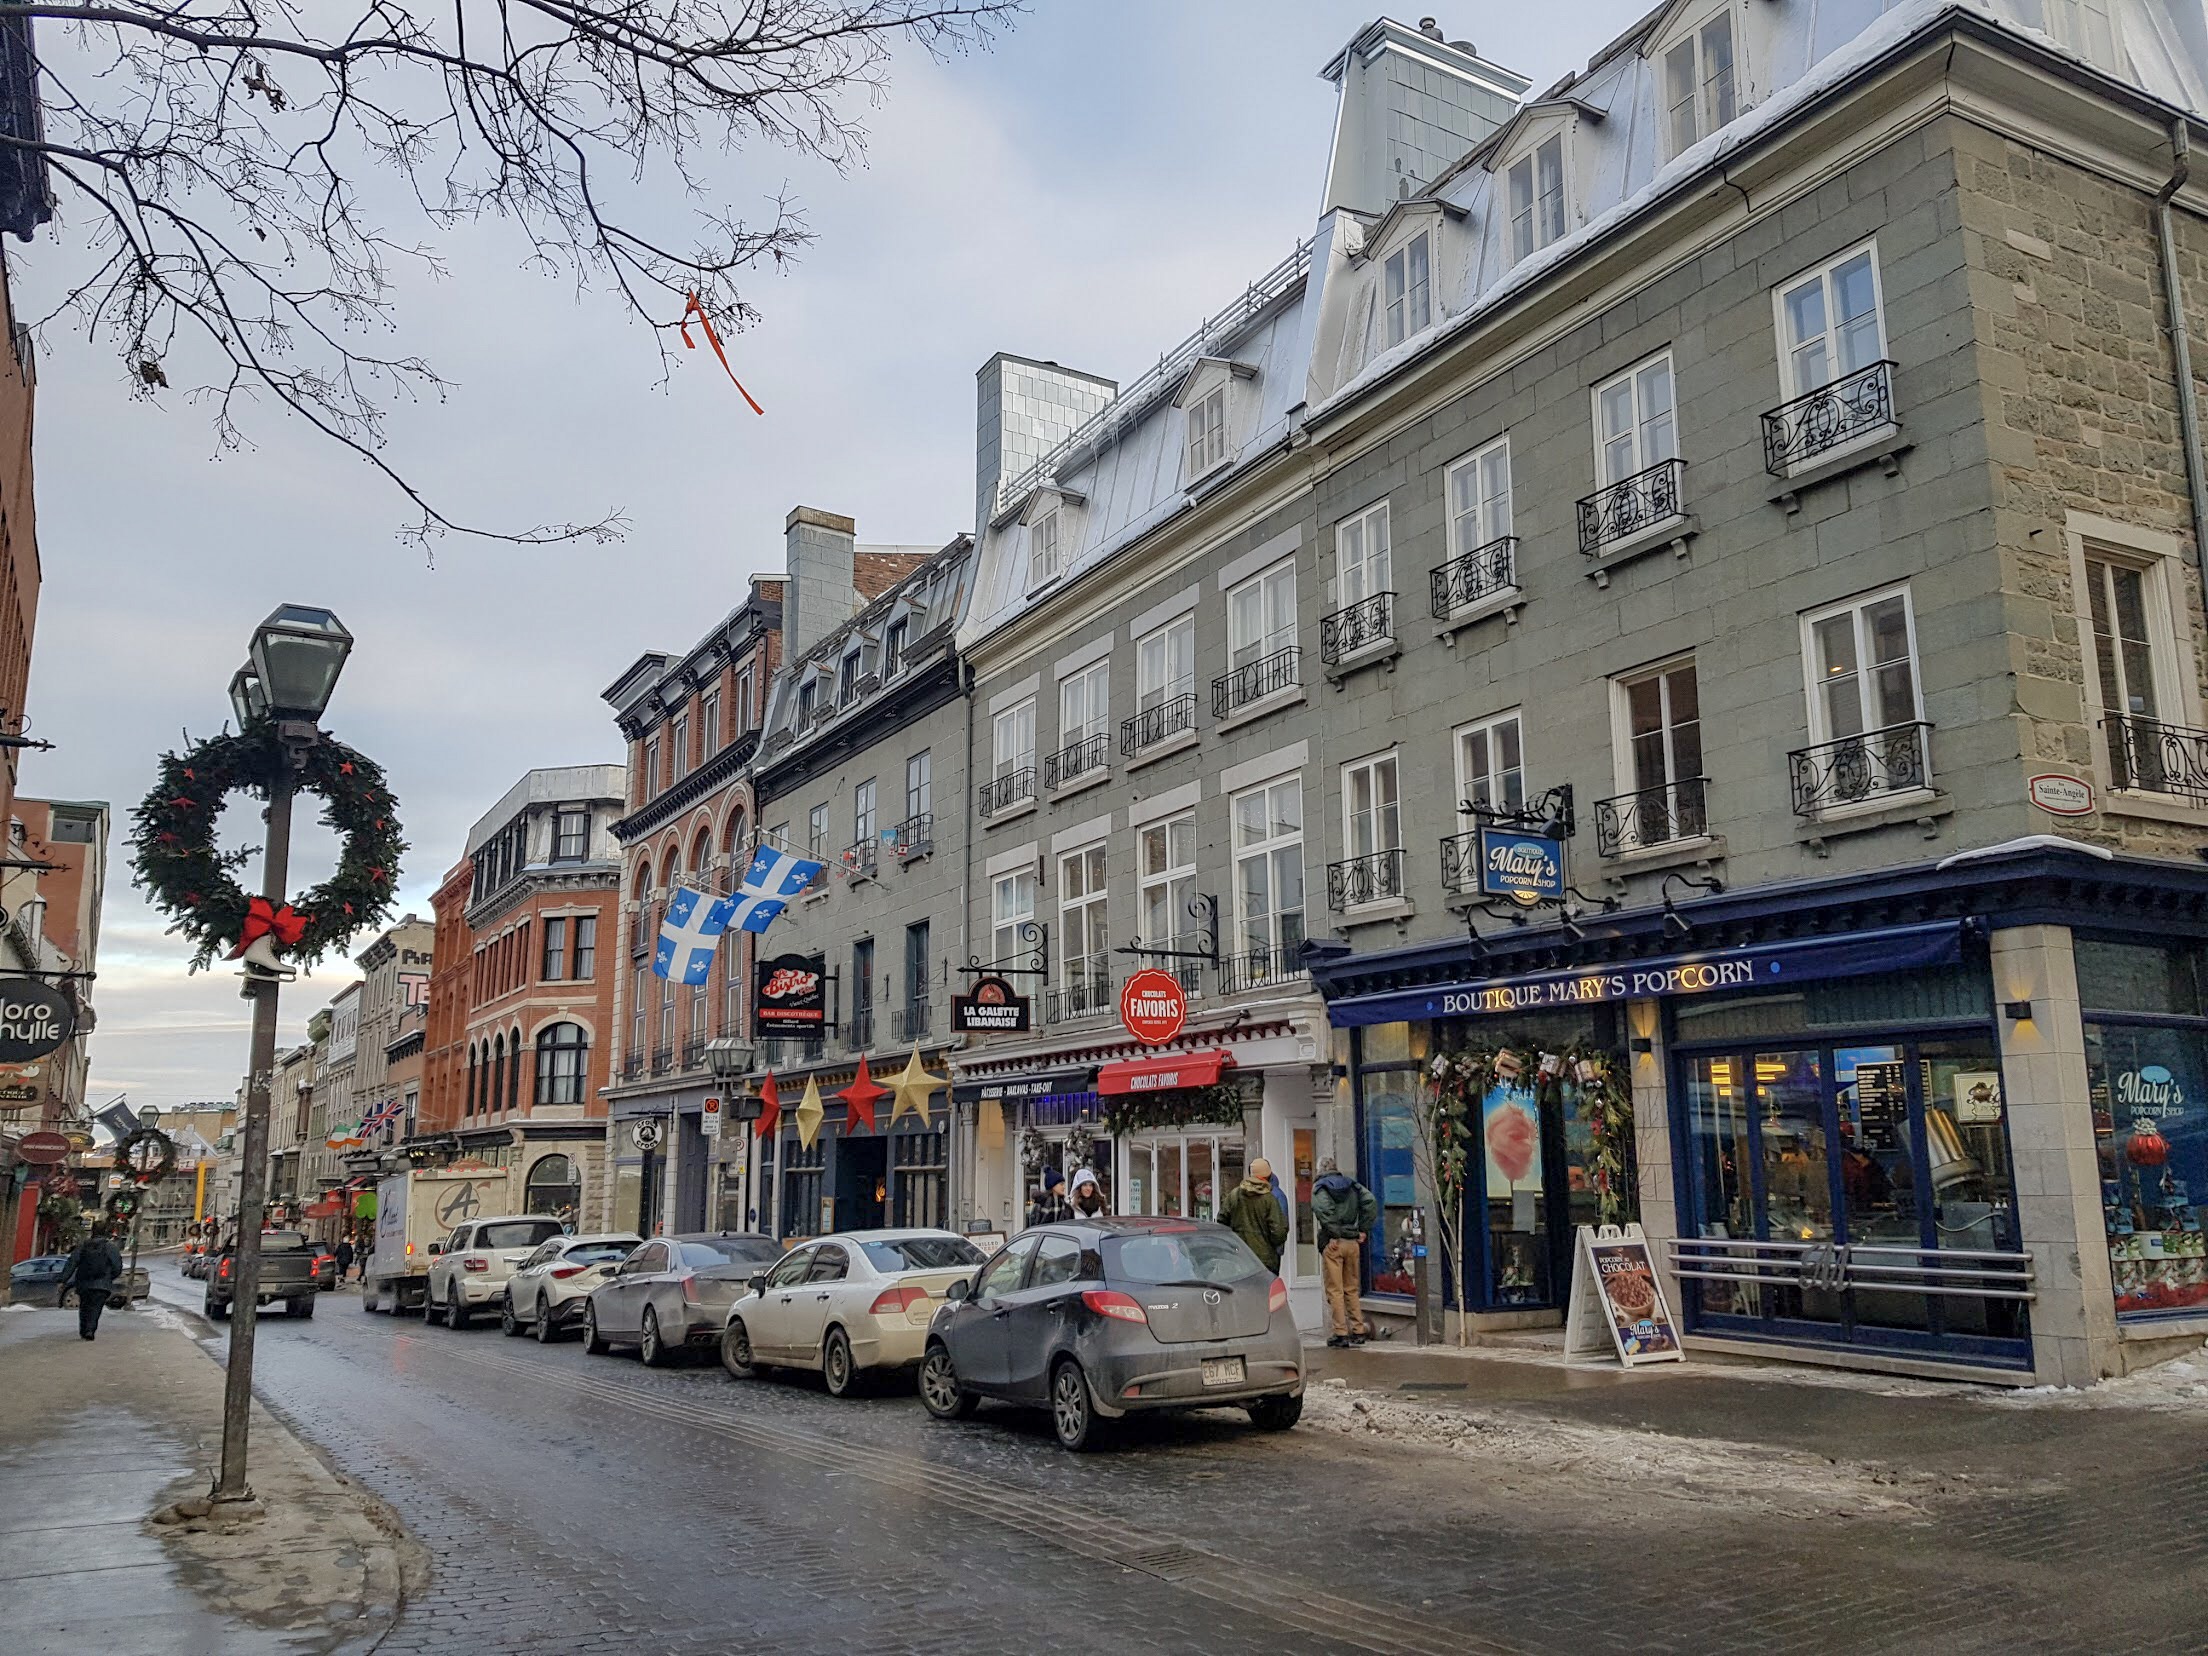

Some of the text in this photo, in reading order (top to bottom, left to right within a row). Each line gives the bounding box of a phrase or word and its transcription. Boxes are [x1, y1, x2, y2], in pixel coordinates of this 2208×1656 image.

[2038, 784, 2085, 799] Sainte-Angèle
[1488, 846, 1558, 887] Mary's
[1500, 874, 1556, 888] POPCORN SHOP
[762, 970, 813, 996] Bistro
[1442, 960, 1755, 1014] BOUTIQUE MARY'S POPCORN
[1141, 990, 1167, 998] CHOCOLATS
[963, 1006, 1020, 1017] LA GALETTE
[1130, 997, 1179, 1018] FAVORIS
[966, 1016, 1017, 1028] LIBANAISE
[1130, 1071, 1179, 1090] CHOCOLATS FAVORIS
[2117, 1071, 2185, 1118] Mary's
[2130, 1105, 2185, 1117] POPCORN SHOP
[636, 1139, 659, 1150] crocs
[1598, 1256, 1623, 1264] POPCORN
[1601, 1261, 1646, 1274] CHOCOLAT
[1629, 1323, 1661, 1339] Mary's
